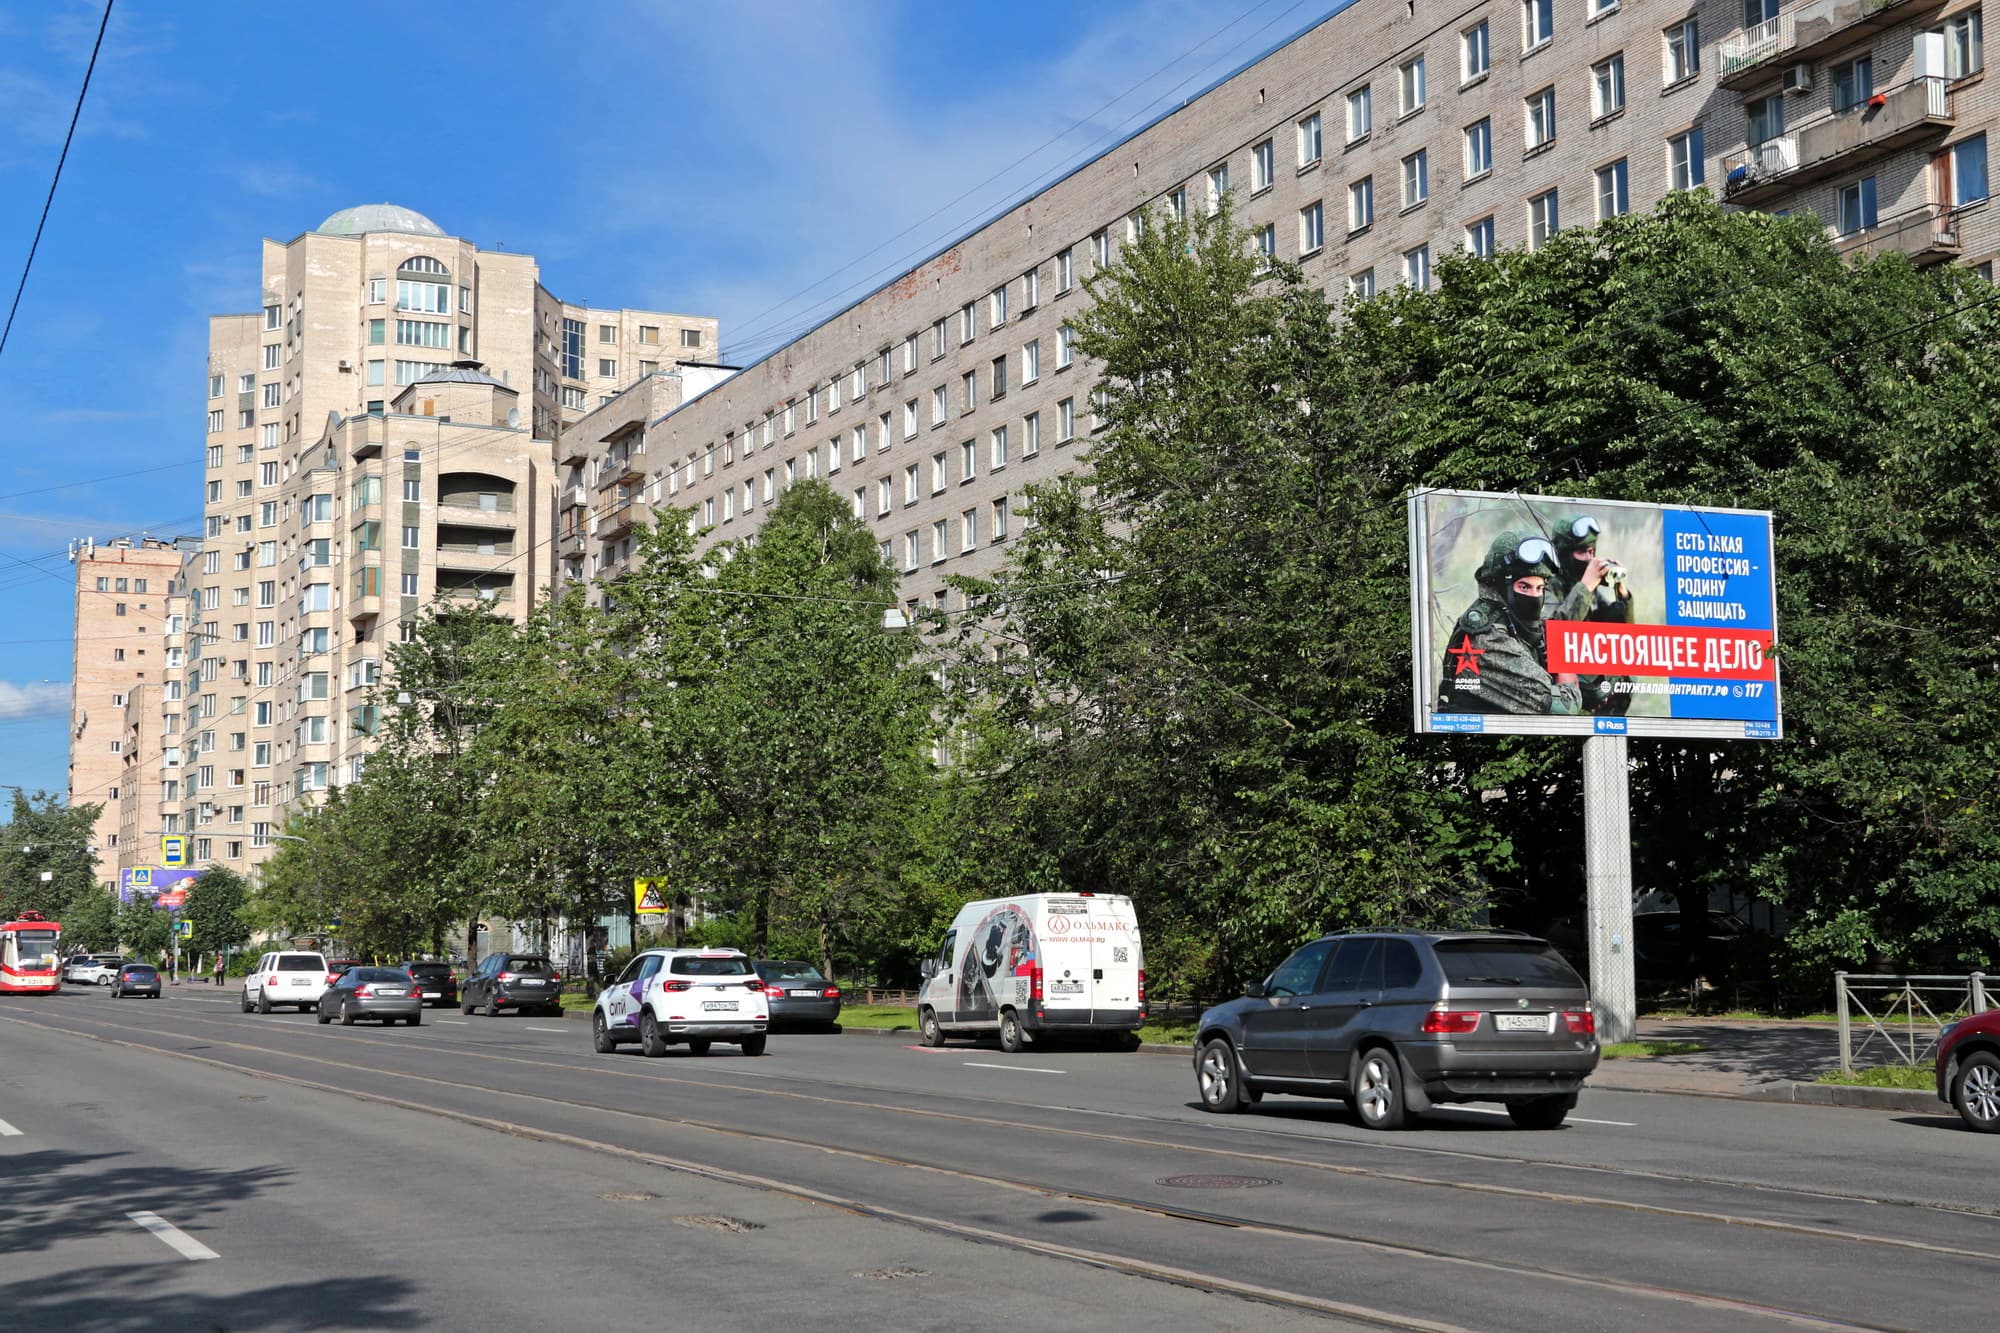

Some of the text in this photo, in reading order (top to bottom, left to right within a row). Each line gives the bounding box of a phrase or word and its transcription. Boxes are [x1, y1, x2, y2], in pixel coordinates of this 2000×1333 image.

[1676, 532, 1743, 554] ЕСТЬ ТАКАЯ
[1677, 555, 1750, 576] ПРОФЕССИЯ
[1677, 577, 1726, 598] РОДИНУ
[1678, 600, 1746, 622] ЗАЩИЩАТЬ
[1563, 631, 1763, 672] НАСТОЯЩЕЕ ДЕЛО
[1613, 681, 1764, 698] СЛУЖБАПОКОНТРАКТУ.РФ 117
[1606, 722, 1625, 730] Russ
[1073, 921, 1130, 932] ОЛЬМАКС
[609, 1000, 626, 1016] СИТИ
